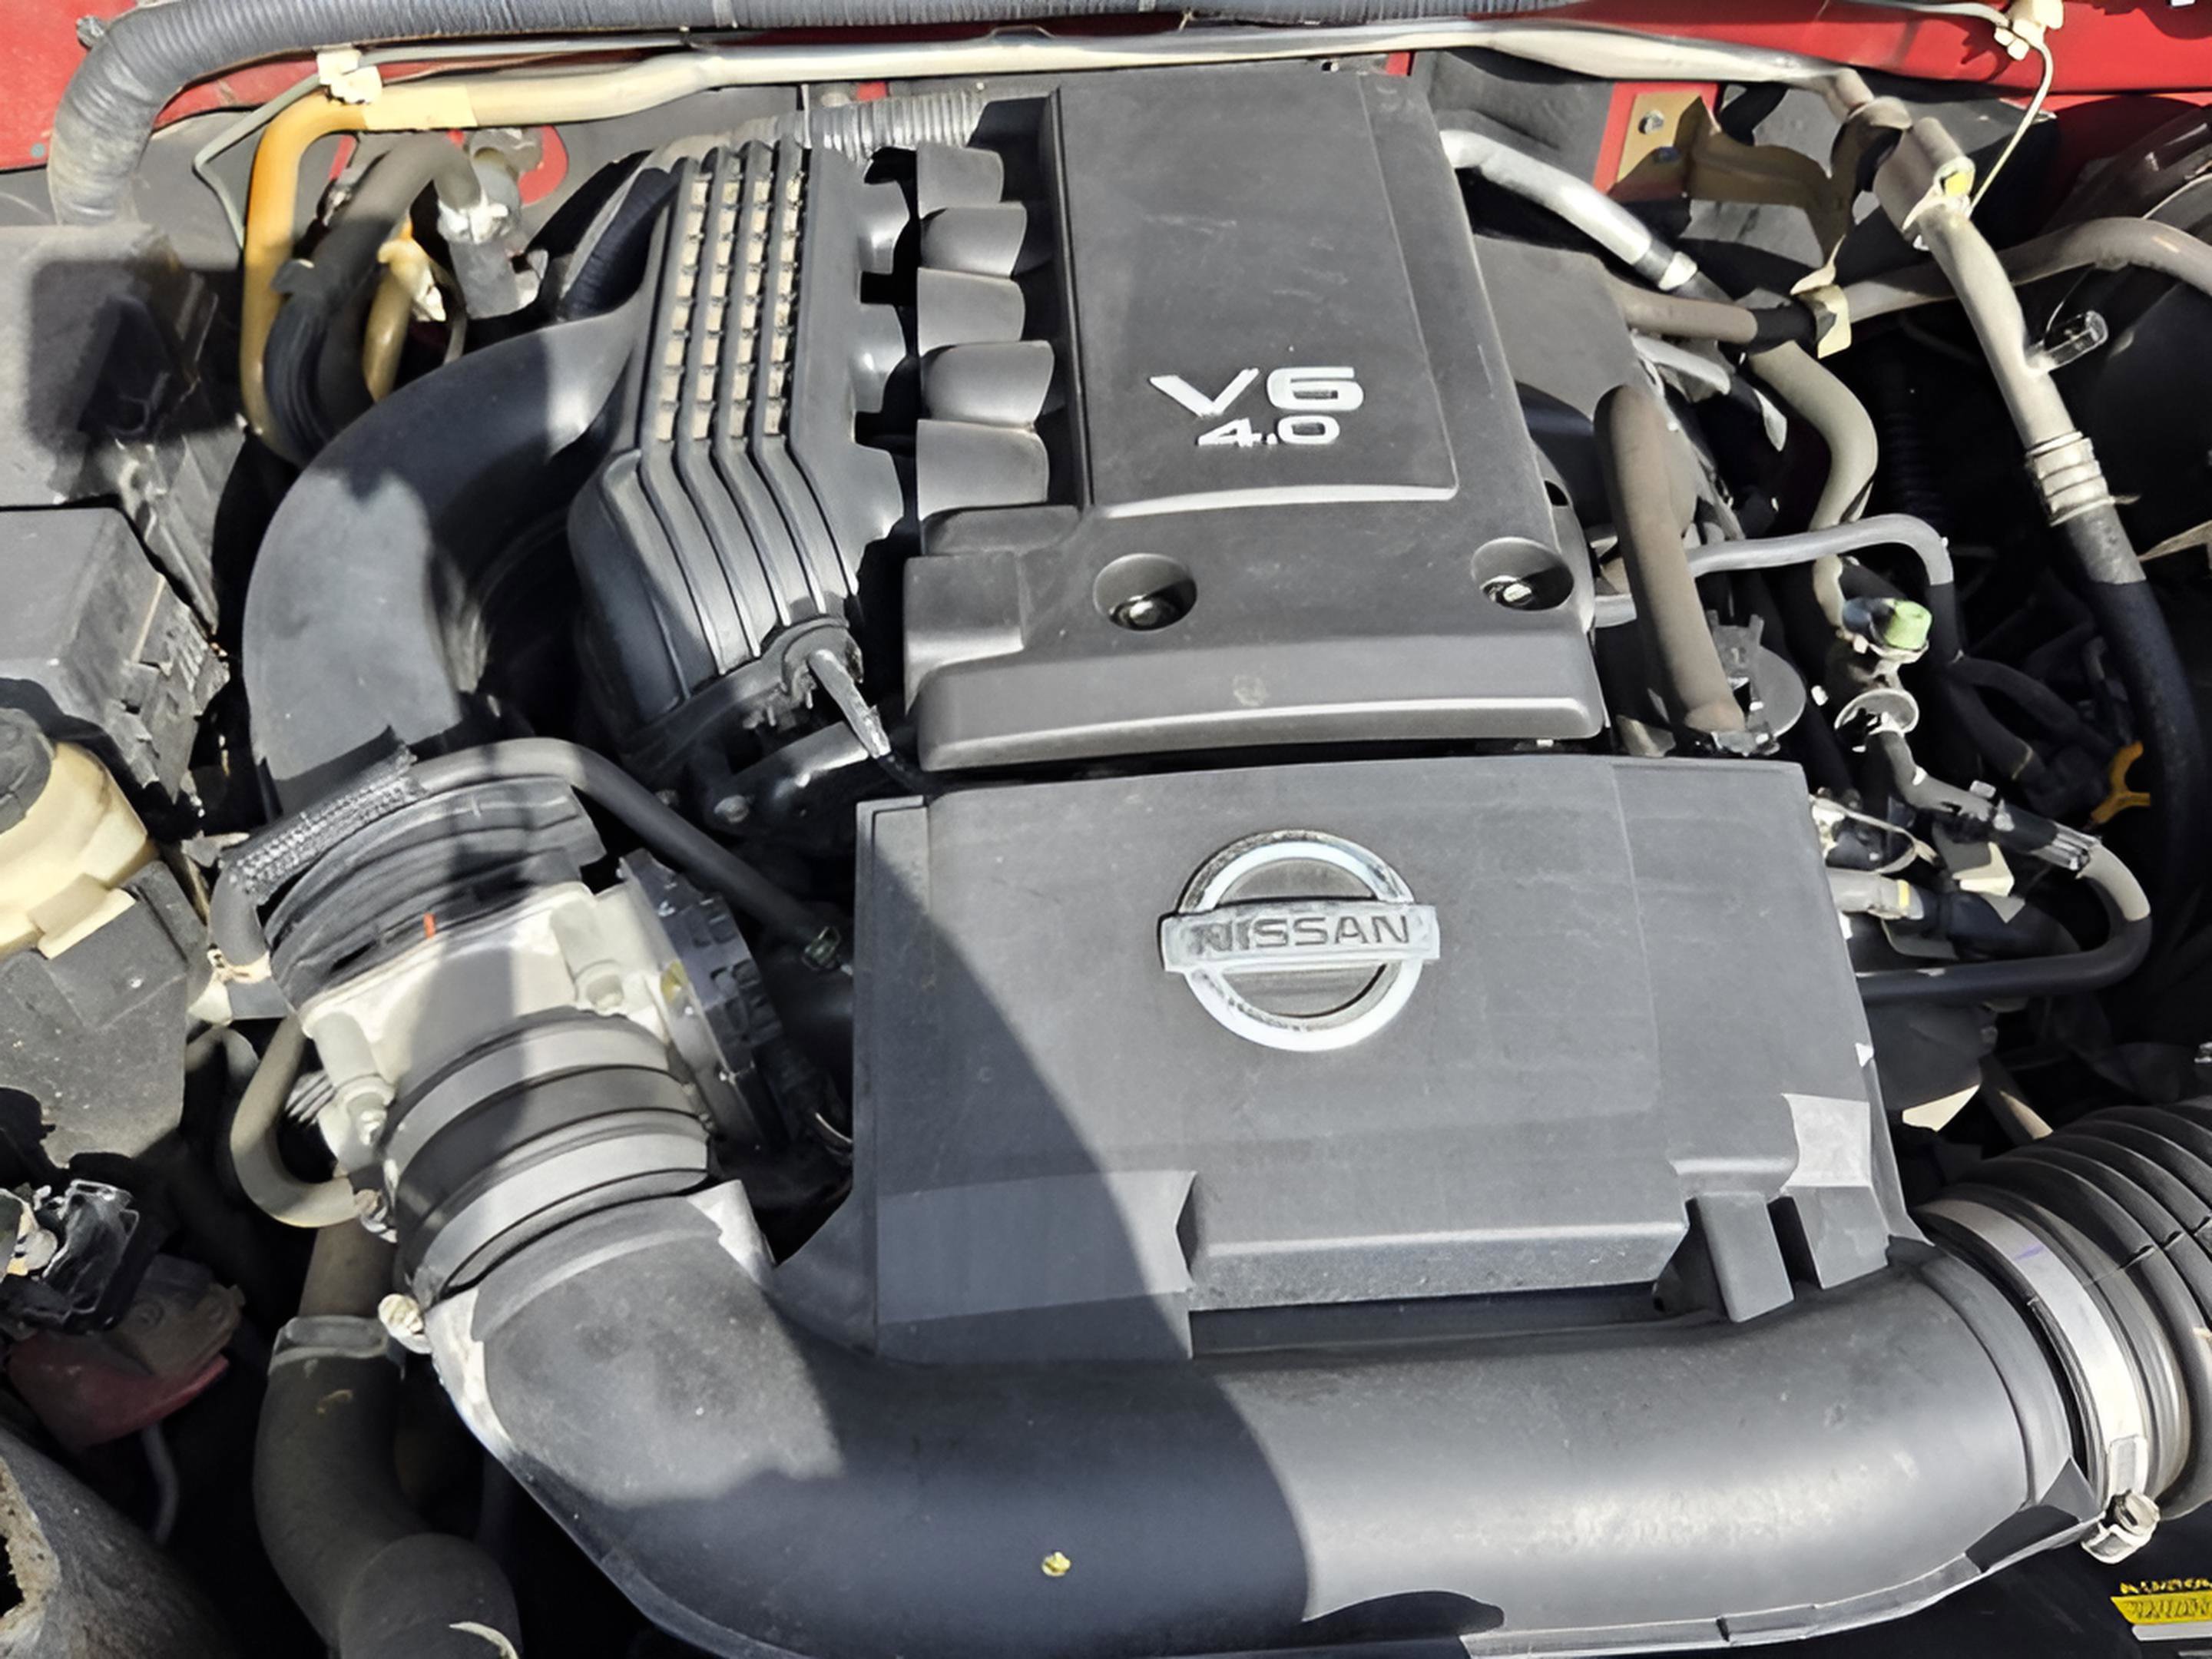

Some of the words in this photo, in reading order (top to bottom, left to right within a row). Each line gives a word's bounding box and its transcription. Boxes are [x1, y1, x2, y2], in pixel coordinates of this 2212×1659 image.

[1150, 366, 1364, 417] V6
[1198, 415, 1340, 447] 4.0
[1189, 915, 1410, 954] NISSAN
